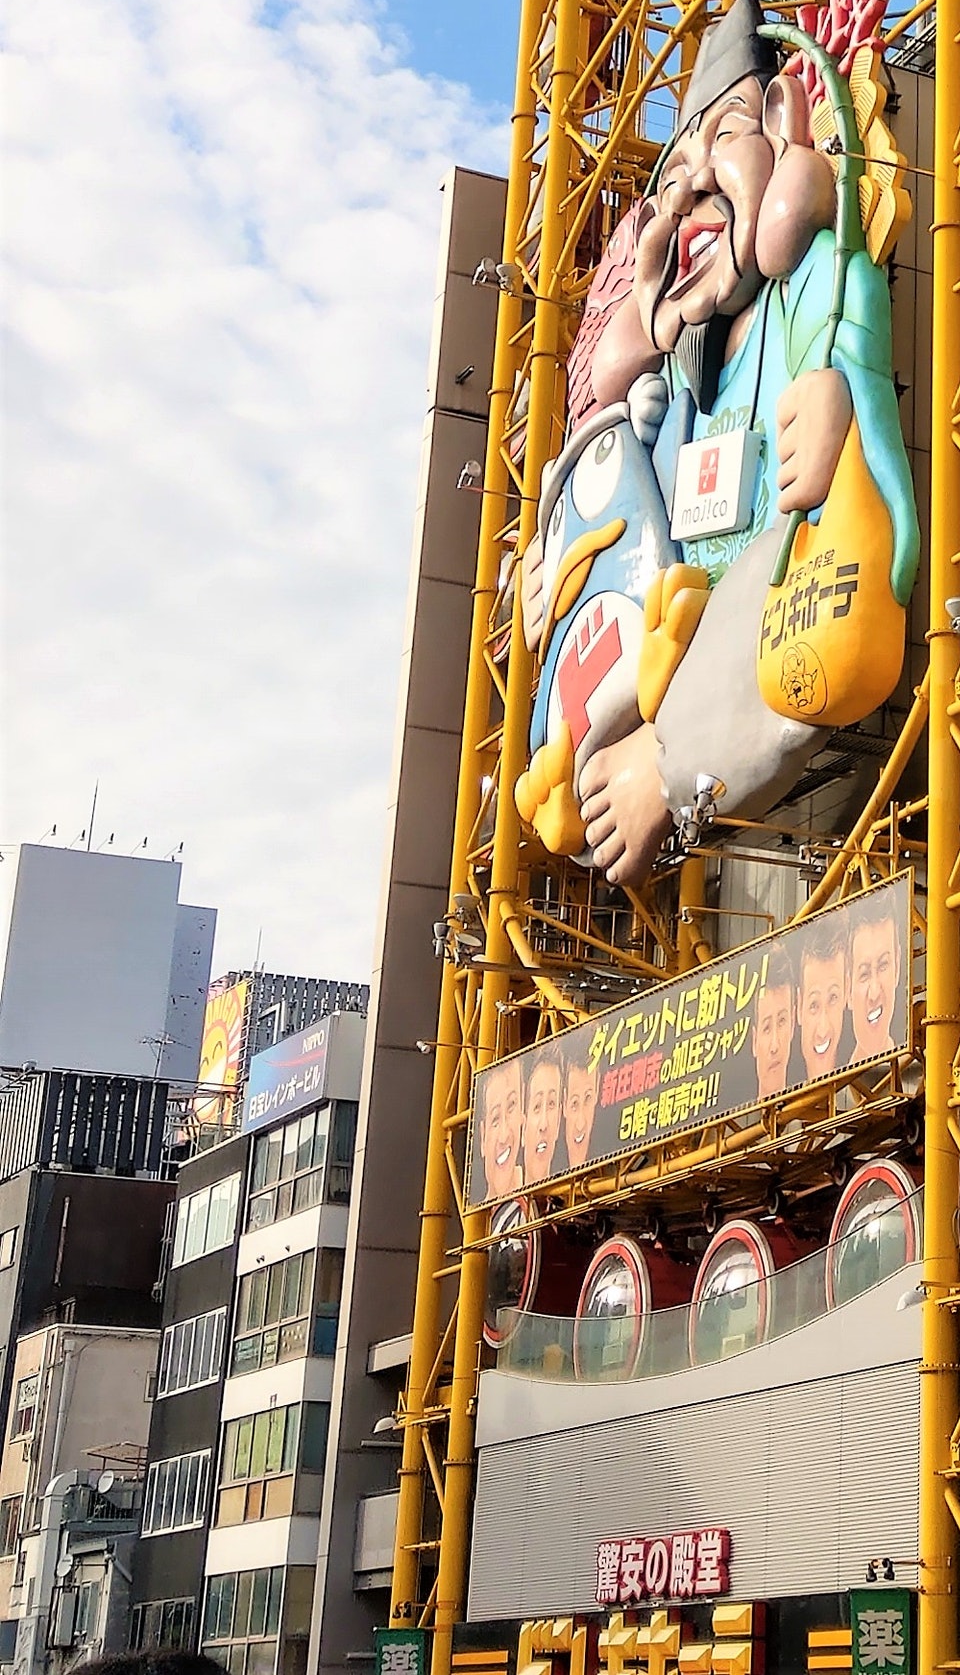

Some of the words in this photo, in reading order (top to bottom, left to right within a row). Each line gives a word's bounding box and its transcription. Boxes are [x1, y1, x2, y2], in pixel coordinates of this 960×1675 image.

[597, 1529, 723, 1603] 驚安の殿堂
[857, 1609, 906, 1668] 薬
